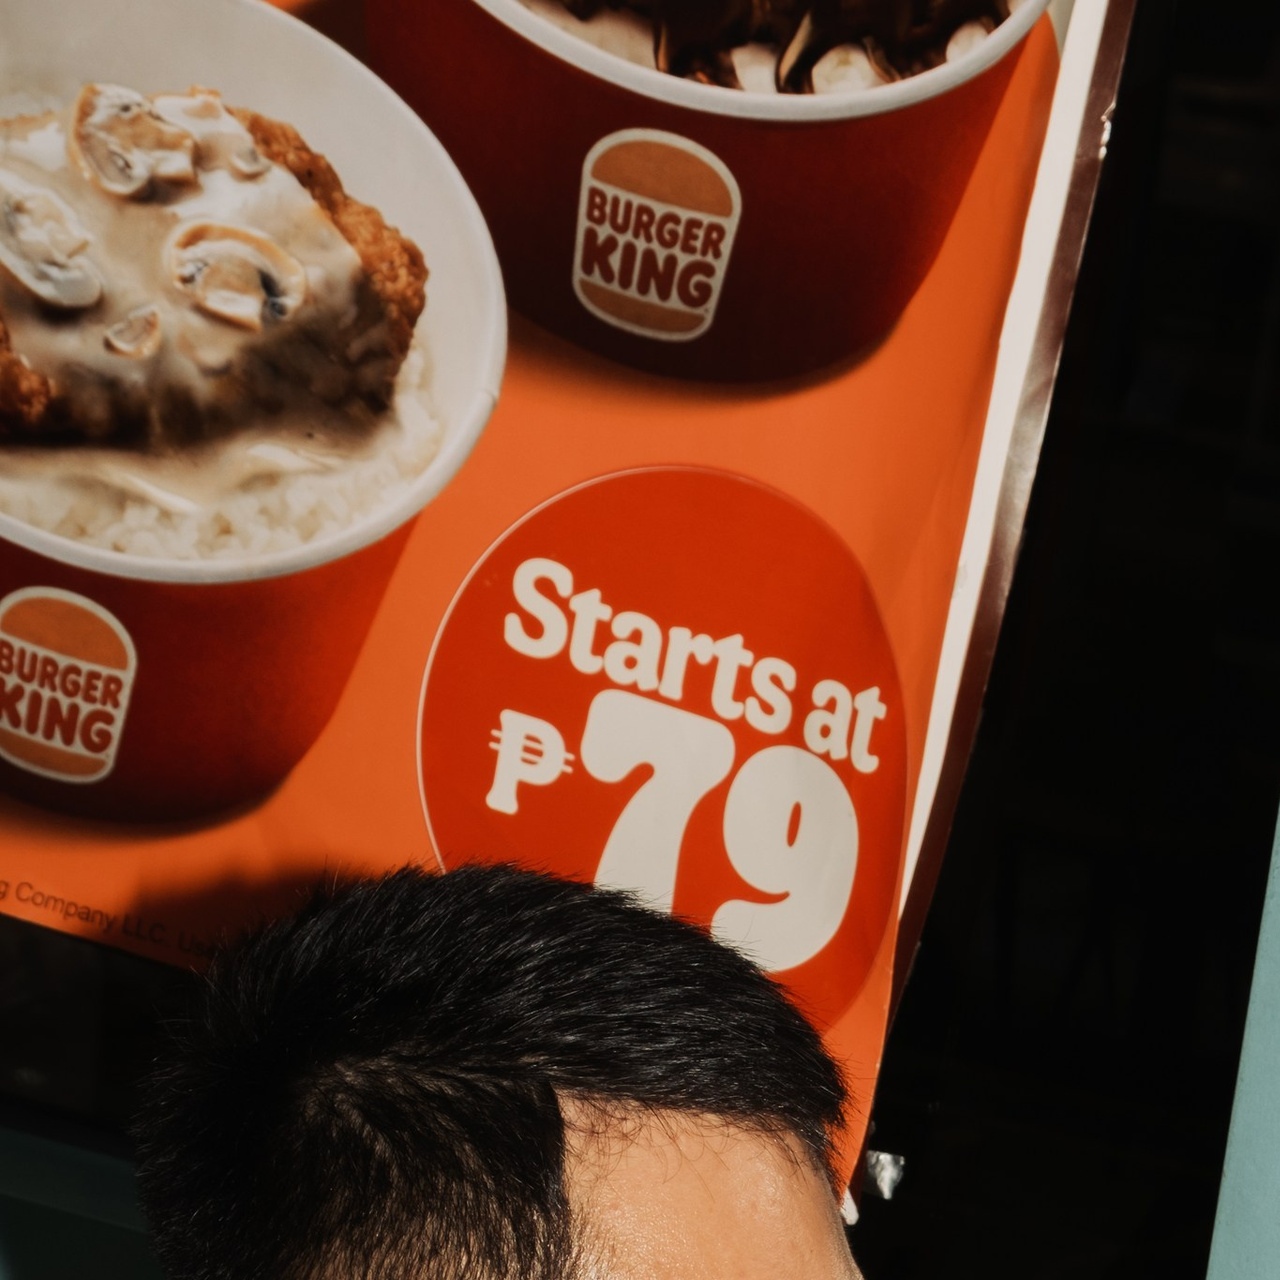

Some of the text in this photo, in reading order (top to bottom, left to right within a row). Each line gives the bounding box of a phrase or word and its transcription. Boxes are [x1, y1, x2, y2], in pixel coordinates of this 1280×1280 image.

[586, 184, 726, 260] BURGER
[580, 226, 717, 309] KING
[0, 640, 123, 710] BURGER
[504, 557, 887, 774] Starts at
[15, 881, 118, 934] Company
